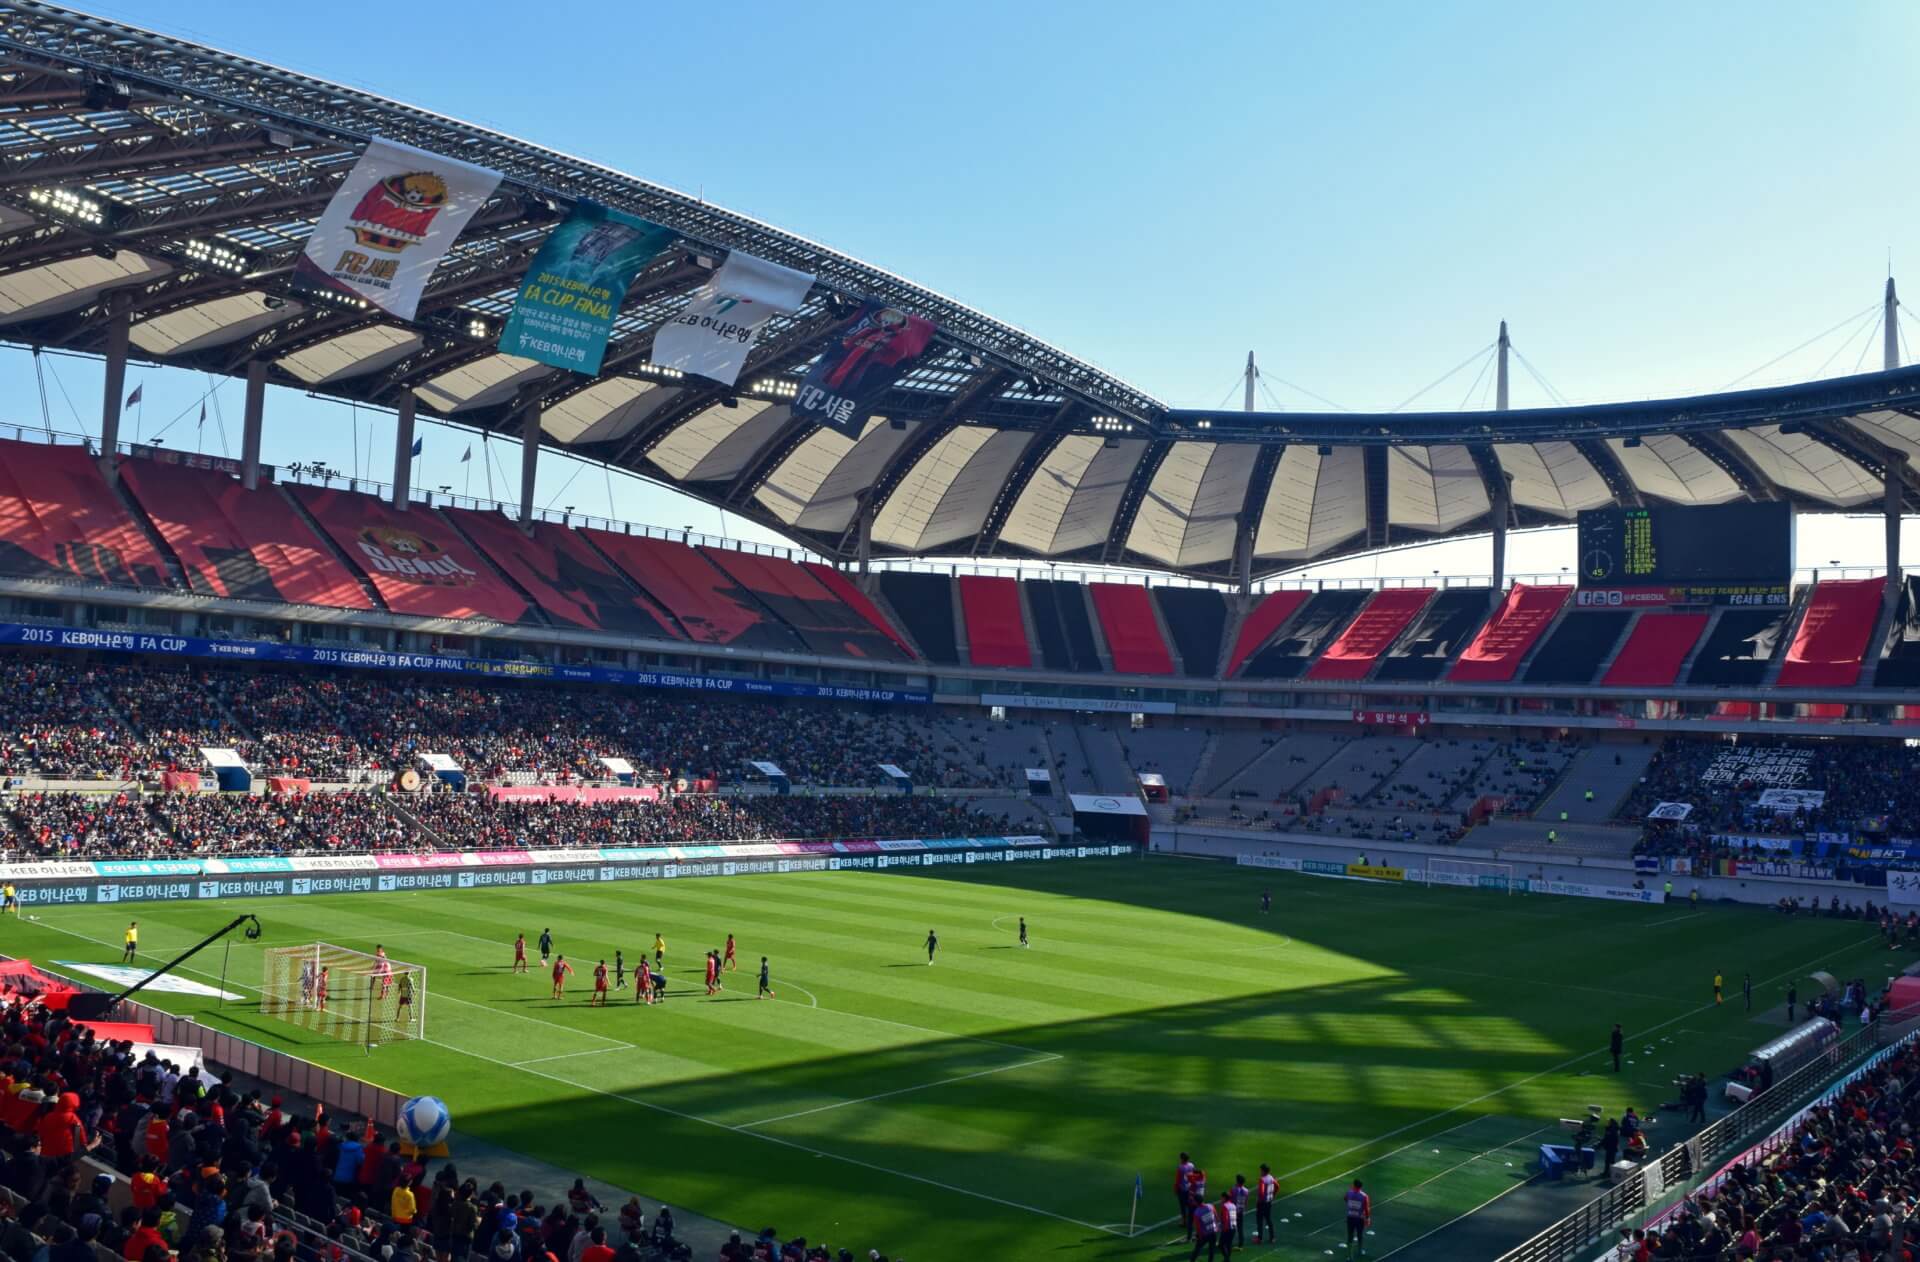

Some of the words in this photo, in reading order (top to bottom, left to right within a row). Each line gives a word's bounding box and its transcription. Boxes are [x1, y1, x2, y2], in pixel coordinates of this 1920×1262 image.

[334, 251, 369, 274] FC
[538, 272, 560, 286] 2015
[524, 284, 541, 301] FA
[543, 289, 575, 308] CUP
[574, 297, 612, 320] FINAL
[700, 315, 752, 344] 하나은행
[530, 338, 550, 352] KEB
[551, 343, 587, 362] 하나은행
[796, 385, 818, 411] FC
[821, 395, 856, 425] 서울
[1766, 594, 1787, 605] SNS
[22, 628, 54, 643] 2015
[61, 632, 135, 649] KEB하나은행
[140, 637, 157, 650] FA
[160, 639, 188, 652] CUP
[313, 650, 338, 662] 2015
[340, 652, 396, 667] KEB하나은행
[398, 654, 412, 667] FA
[413, 656, 434, 669] CUP
[435, 658, 463, 671] FINAL
[638, 673, 657, 684] 2015
[705, 677, 716, 689] FA
[717, 678, 733, 690] CUP
[818, 686, 833, 697] 2015
[871, 690, 881, 701] FA
[881, 691, 895, 702] CUP
[10, 866, 38, 876] KEB
[41, 864, 93, 876] 하나은행
[547, 870, 563, 882] KEB
[565, 868, 595, 882] 하나은행
[615, 869, 630, 878] KEB
[677, 866, 691, 876] KEB
[736, 863, 749, 873] KEB
[311, 879, 332, 891] KEB
[334, 877, 371, 891] 하나은행
[397, 876, 415, 888] KEB
[417, 874, 451, 888] 하나은행
[475, 874, 492, 885] KEB
[493, 871, 526, 885] 하나은행
[15, 888, 36, 902] KEB
[40, 886, 88, 903] 하나은행
[120, 886, 144, 899] KEB
[146, 884, 190, 899] 하나은행
[220, 883, 242, 895] KEB
[243, 881, 284, 895] 하나은행
